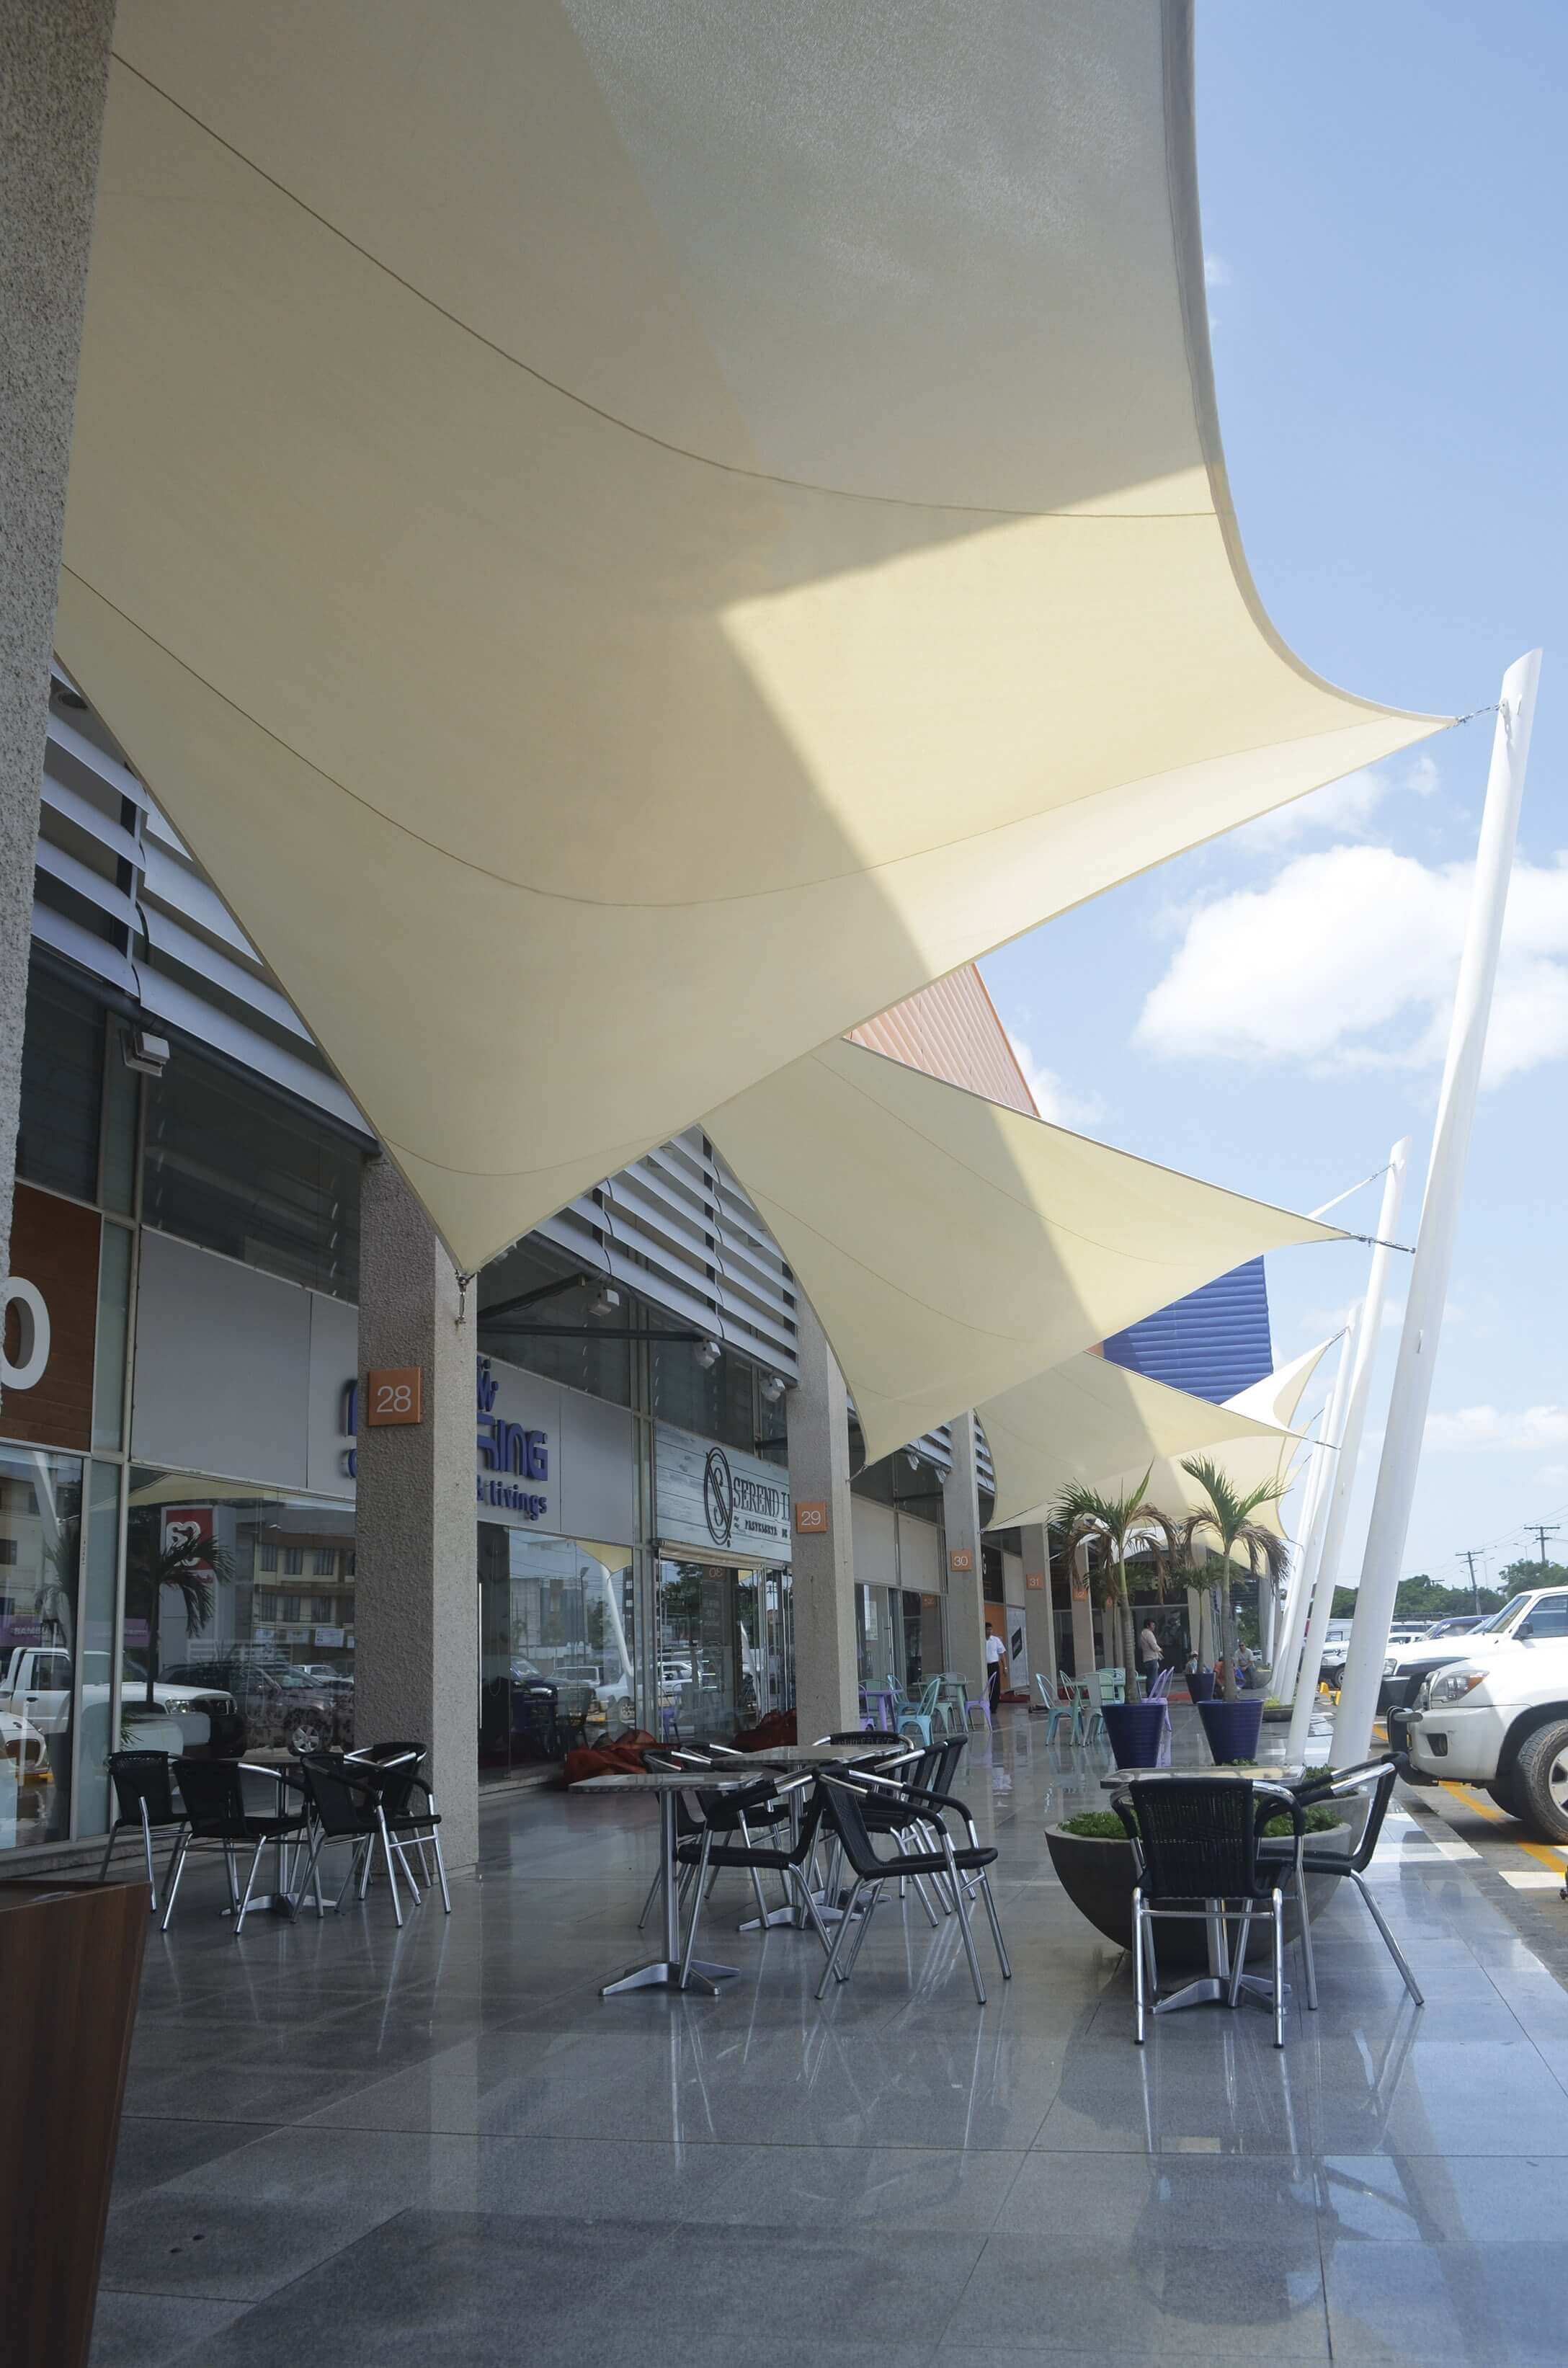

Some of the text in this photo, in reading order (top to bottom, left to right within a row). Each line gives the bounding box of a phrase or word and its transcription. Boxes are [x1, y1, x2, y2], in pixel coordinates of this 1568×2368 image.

[376, 1385, 411, 1413] 28
[801, 1511, 821, 1526] 29
[954, 1556, 968, 1566] 30
